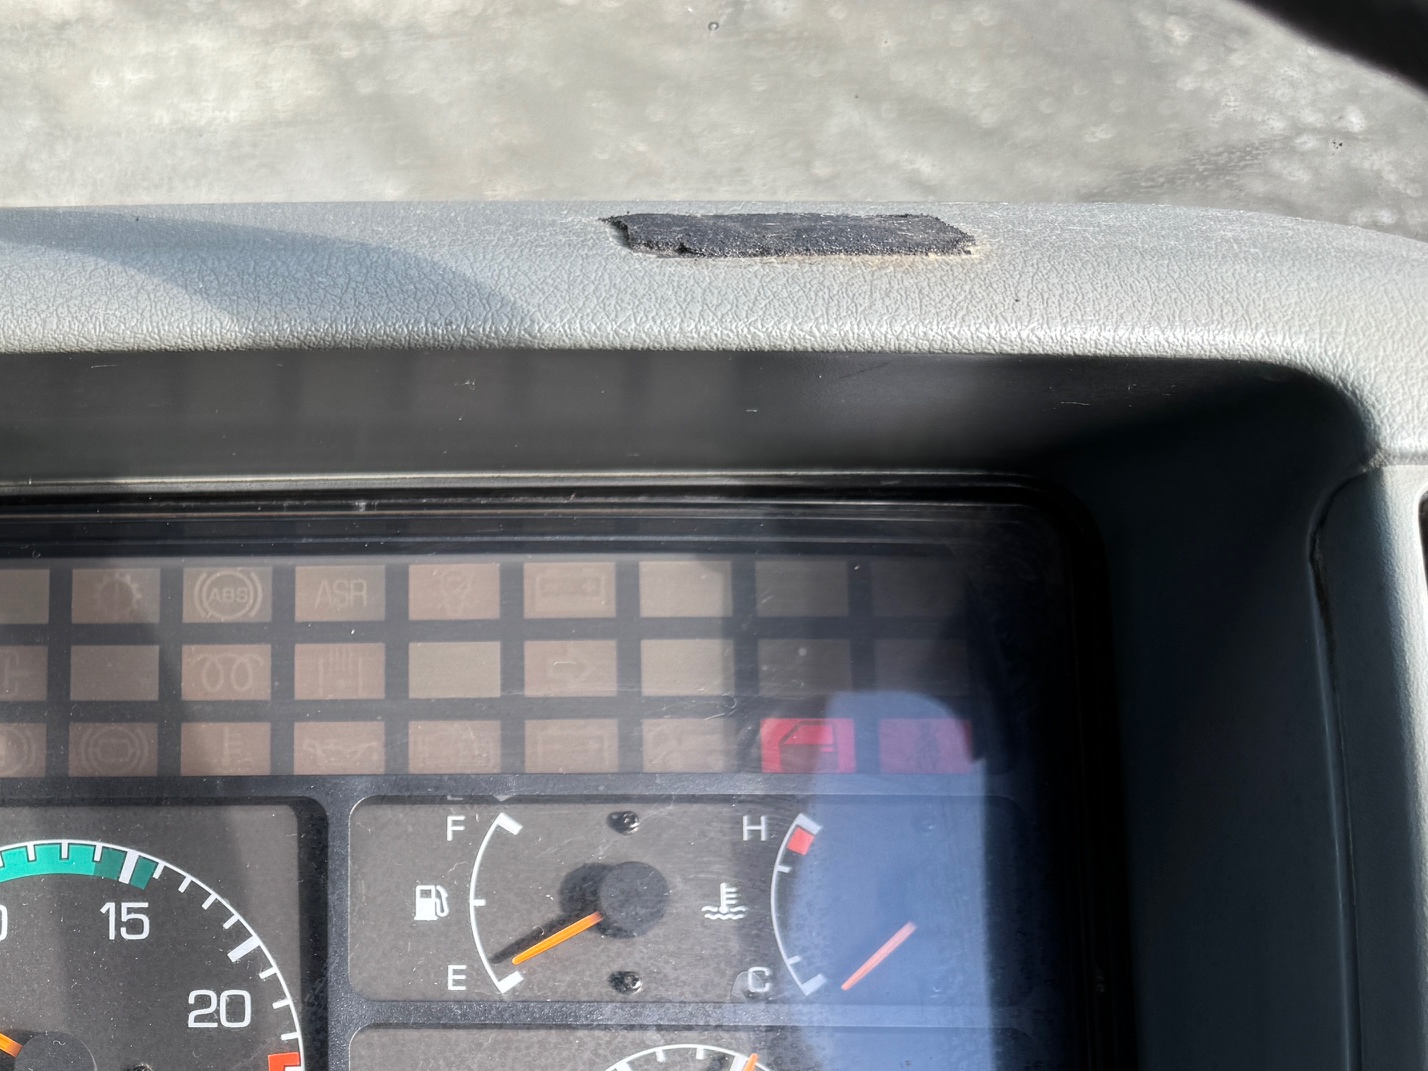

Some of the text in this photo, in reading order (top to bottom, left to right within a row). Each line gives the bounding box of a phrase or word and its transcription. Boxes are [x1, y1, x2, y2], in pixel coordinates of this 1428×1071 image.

[208, 586, 249, 604] ABS
[314, 579, 368, 609] ASR
[446, 815, 466, 841] F
[743, 815, 768, 841] H
[100, 902, 150, 940] 15
[448, 965, 467, 991] E
[746, 967, 771, 993] C
[187, 989, 251, 1028] 20
